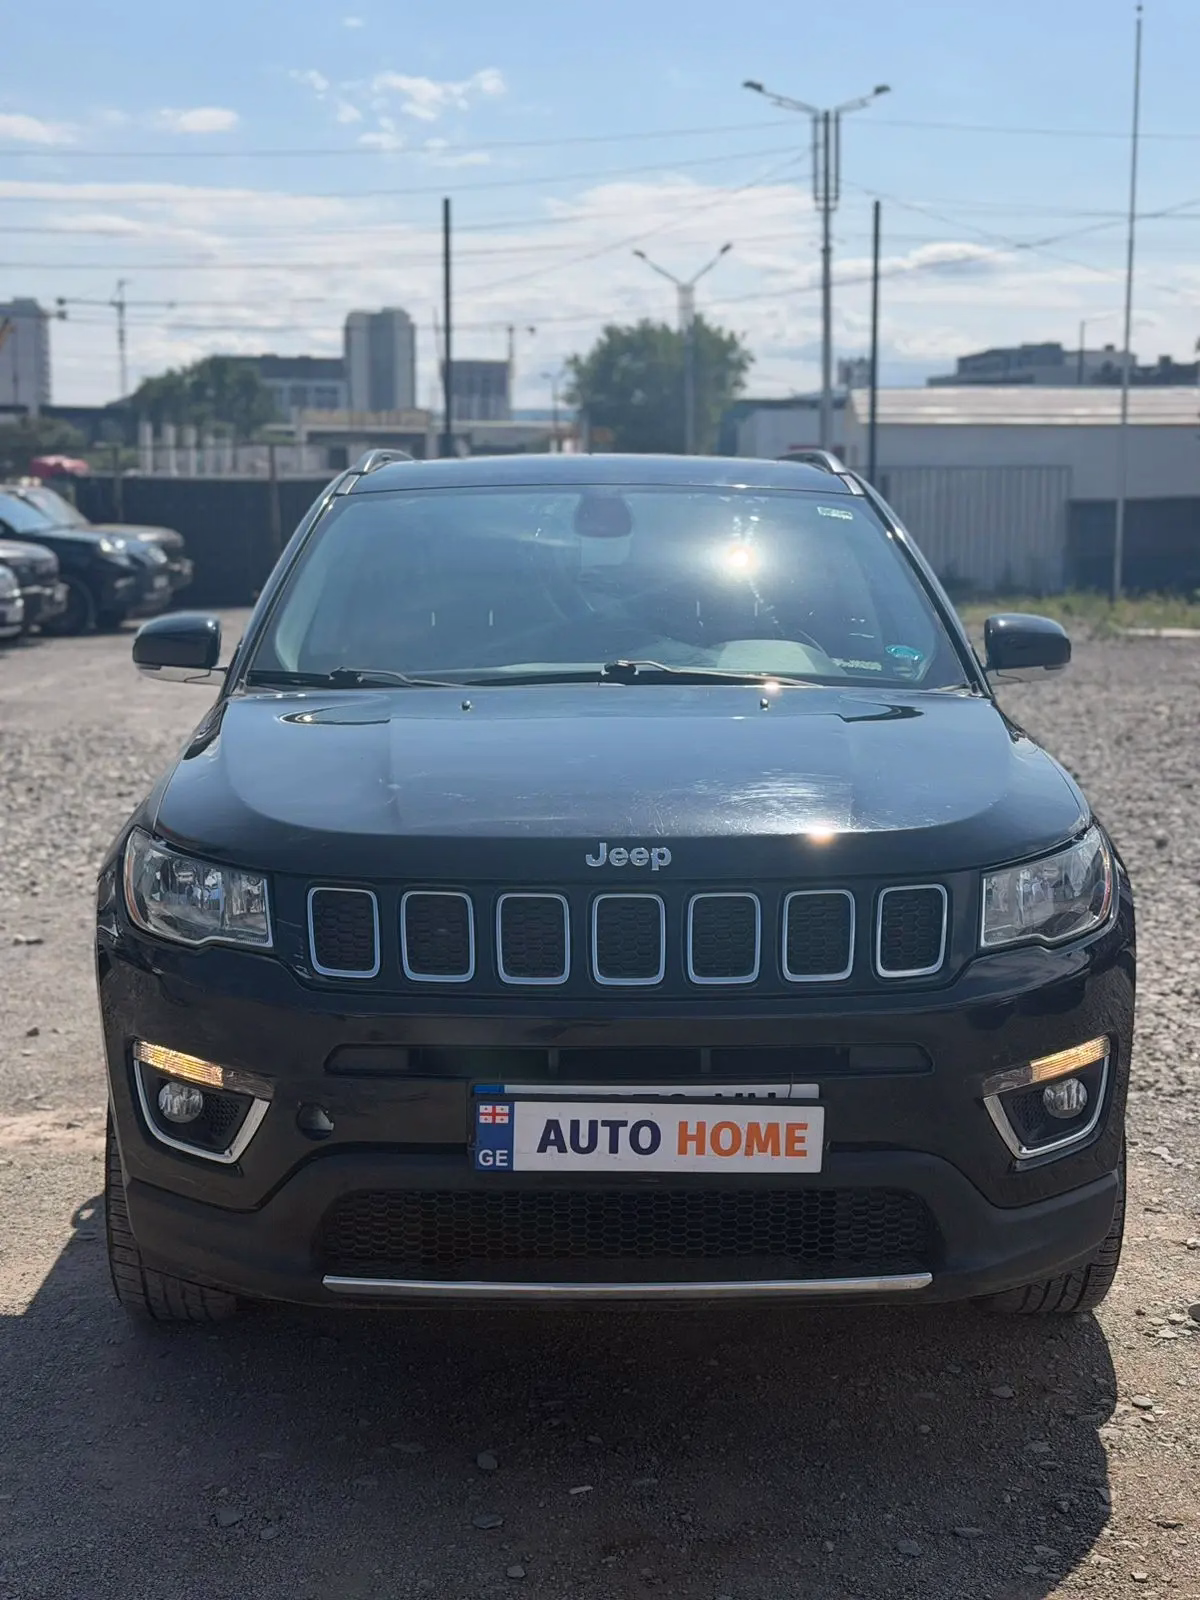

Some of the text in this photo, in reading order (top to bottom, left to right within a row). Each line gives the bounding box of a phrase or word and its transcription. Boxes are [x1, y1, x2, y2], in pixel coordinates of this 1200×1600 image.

[585, 842, 672, 871] Jeep
[536, 1119, 808, 1158] AUTO HOME
[478, 1149, 508, 1167] GE
